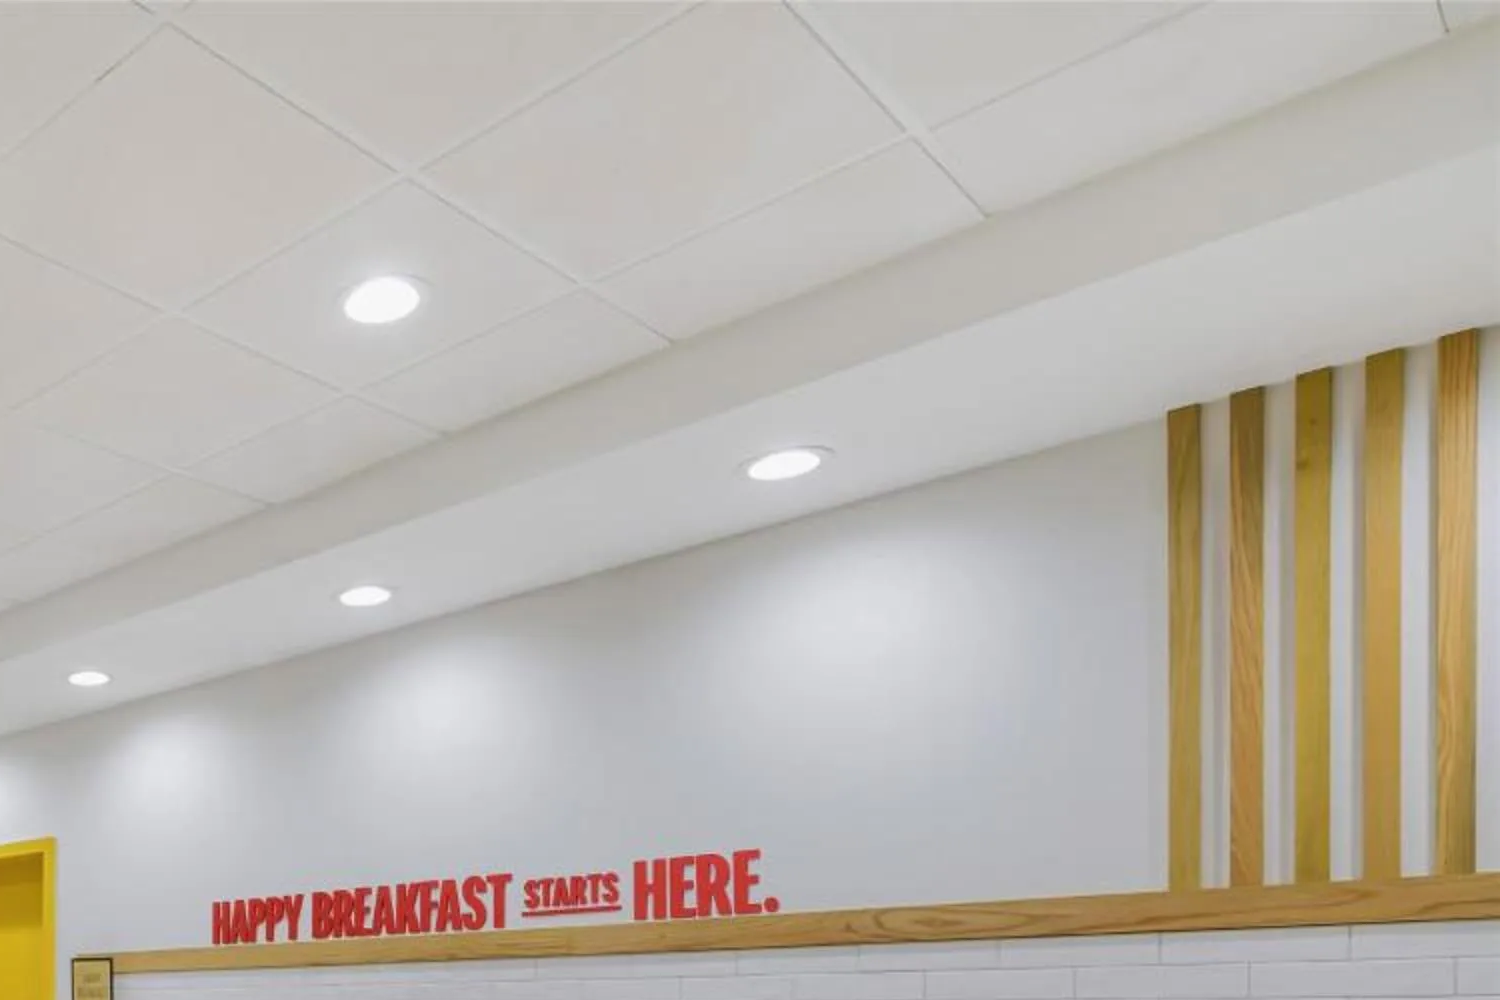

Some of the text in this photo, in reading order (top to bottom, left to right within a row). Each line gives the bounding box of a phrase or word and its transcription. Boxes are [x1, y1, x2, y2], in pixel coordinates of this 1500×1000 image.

[211, 849, 780, 945] HAPPY BREAKFAST STARTS HERE.
